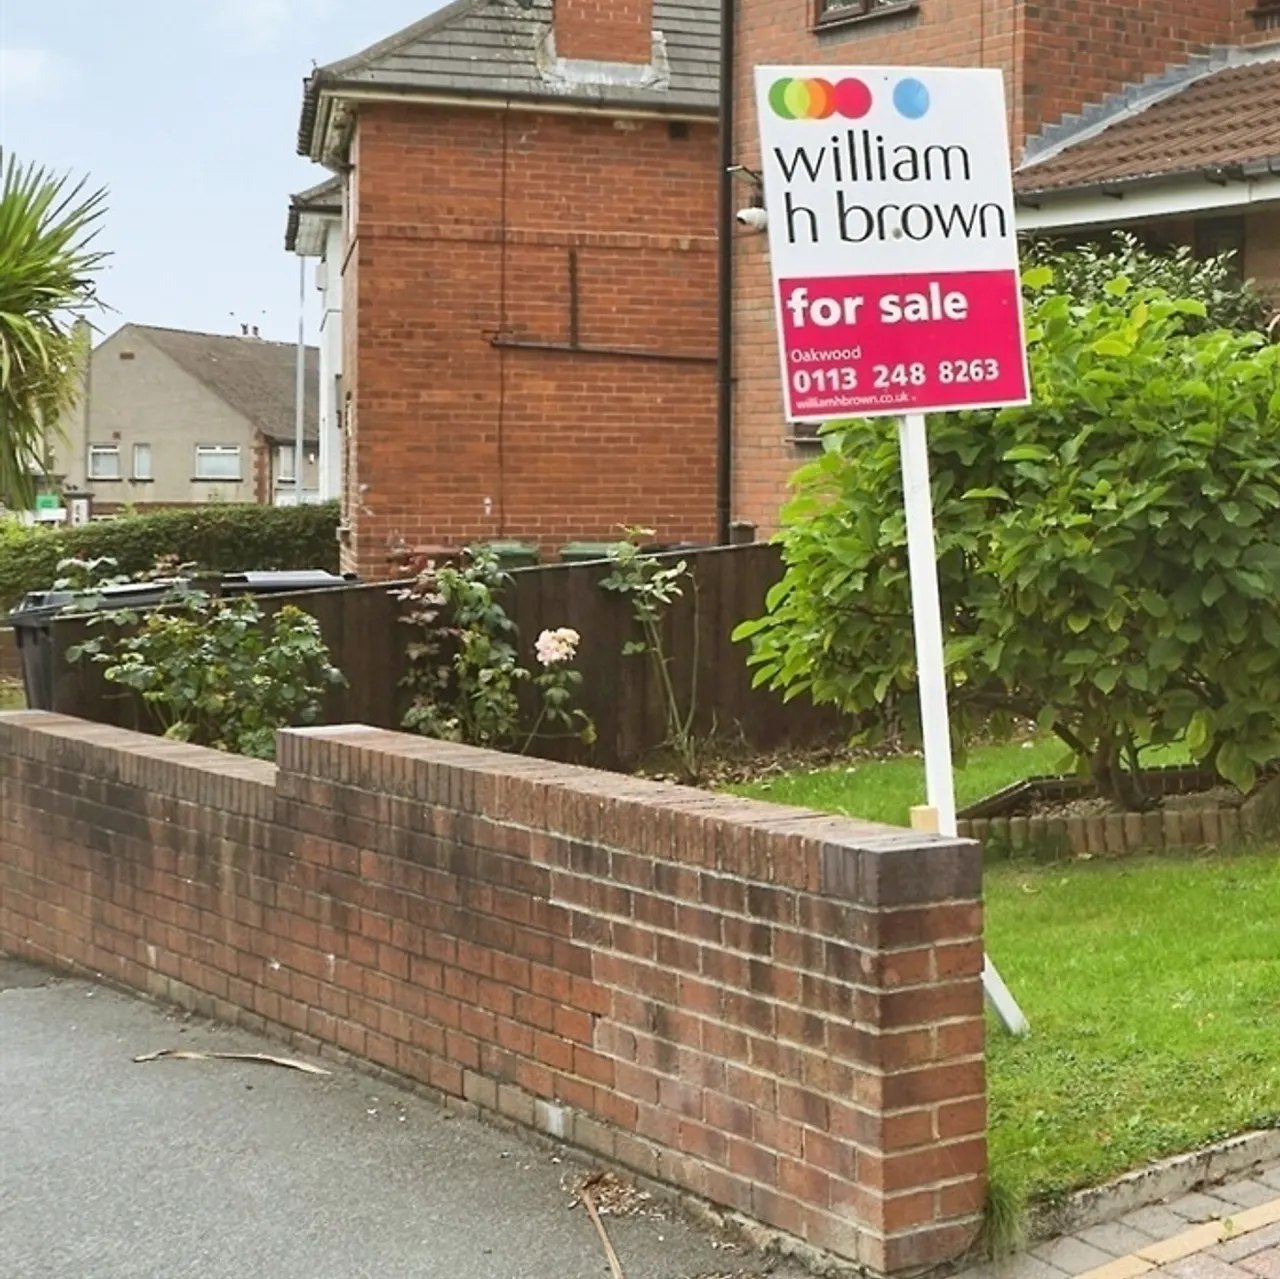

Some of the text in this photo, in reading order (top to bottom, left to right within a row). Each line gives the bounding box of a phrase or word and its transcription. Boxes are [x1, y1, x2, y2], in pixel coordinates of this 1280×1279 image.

[773, 129, 970, 183] william
[784, 190, 1006, 243] h brown
[786, 281, 968, 327] for sale
[791, 345, 861, 363] Oakwood
[793, 358, 999, 393] 0113 248 8263
[796, 391, 908, 409] williamhbrown.co.uk
